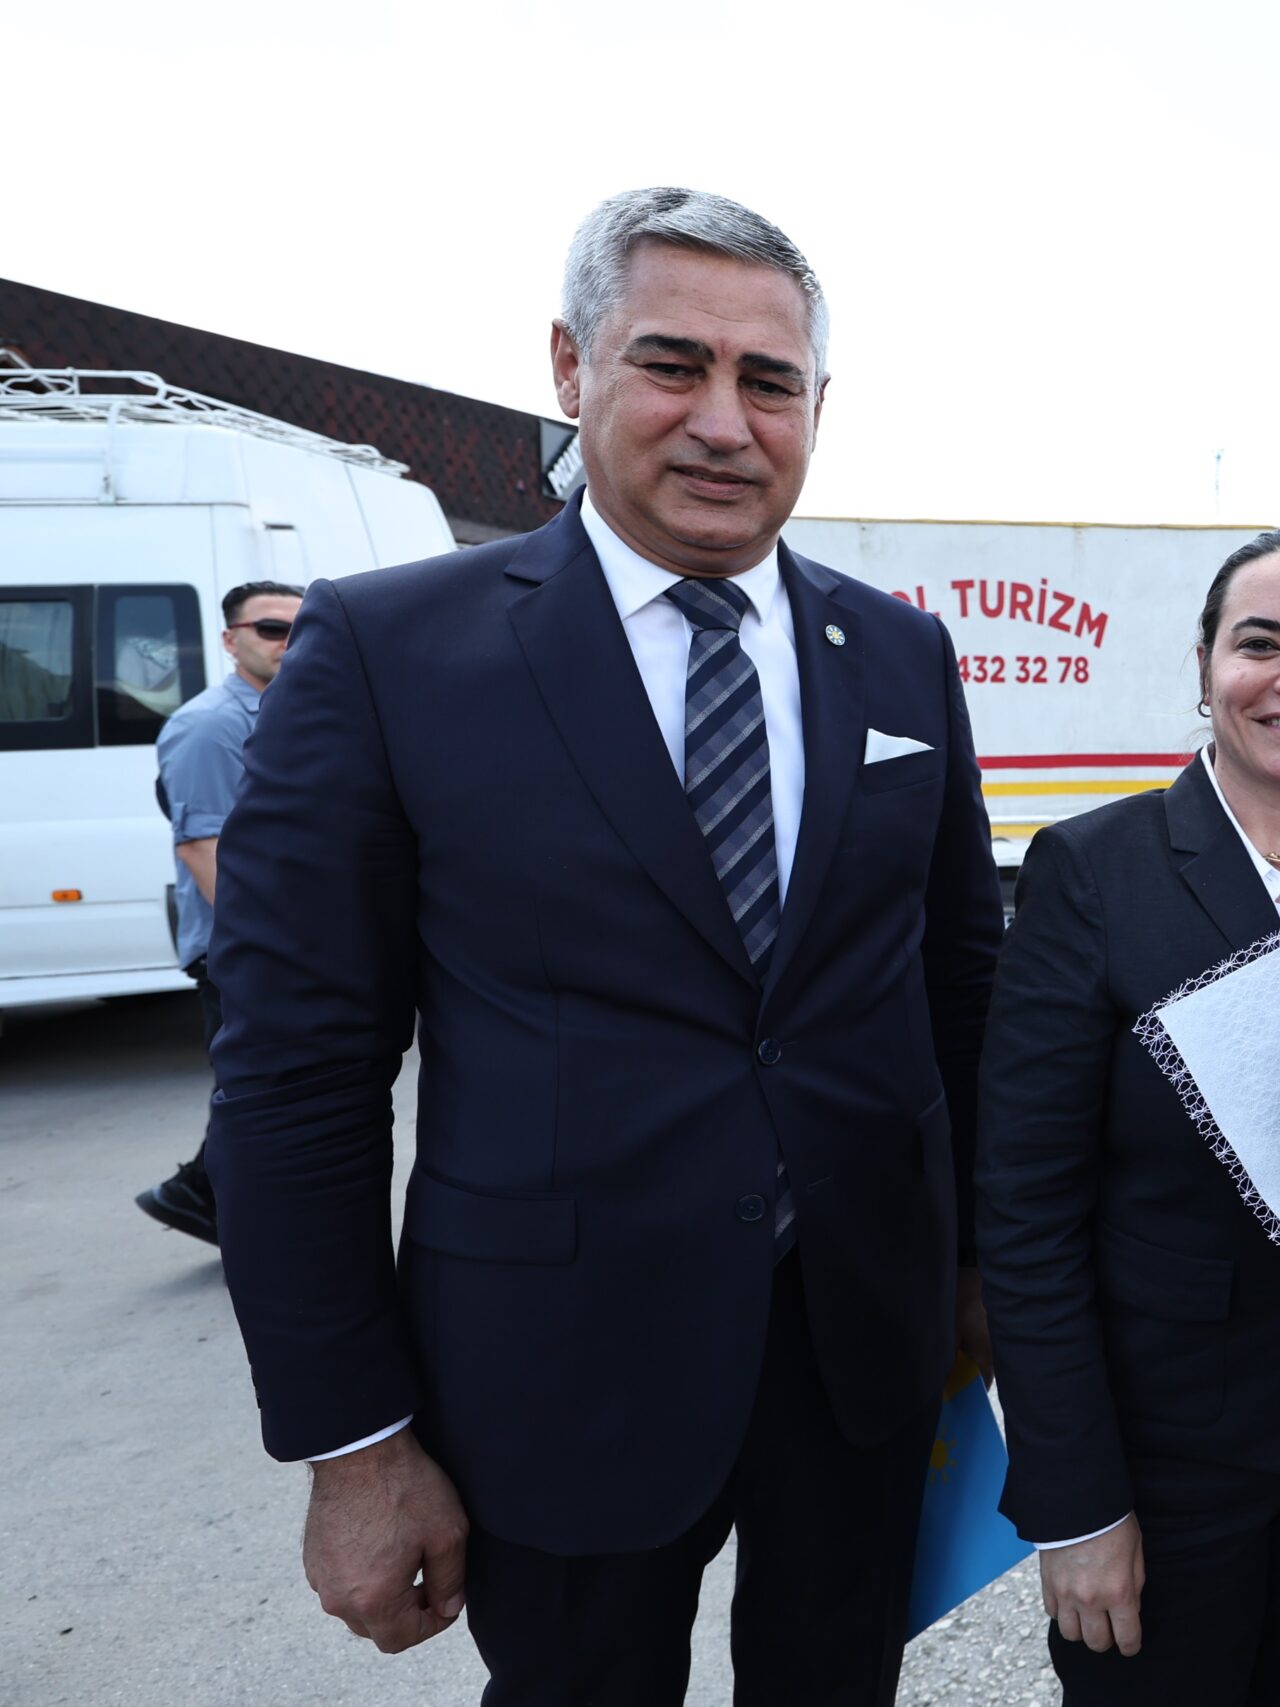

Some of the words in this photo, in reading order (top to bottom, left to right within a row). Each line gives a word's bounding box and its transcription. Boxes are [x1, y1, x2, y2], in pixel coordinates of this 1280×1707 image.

[950, 577, 1109, 649] TURİZM
[958, 655, 1006, 684] 432
[1015, 655, 1048, 684] 32
[1057, 656, 1089, 684] 78
